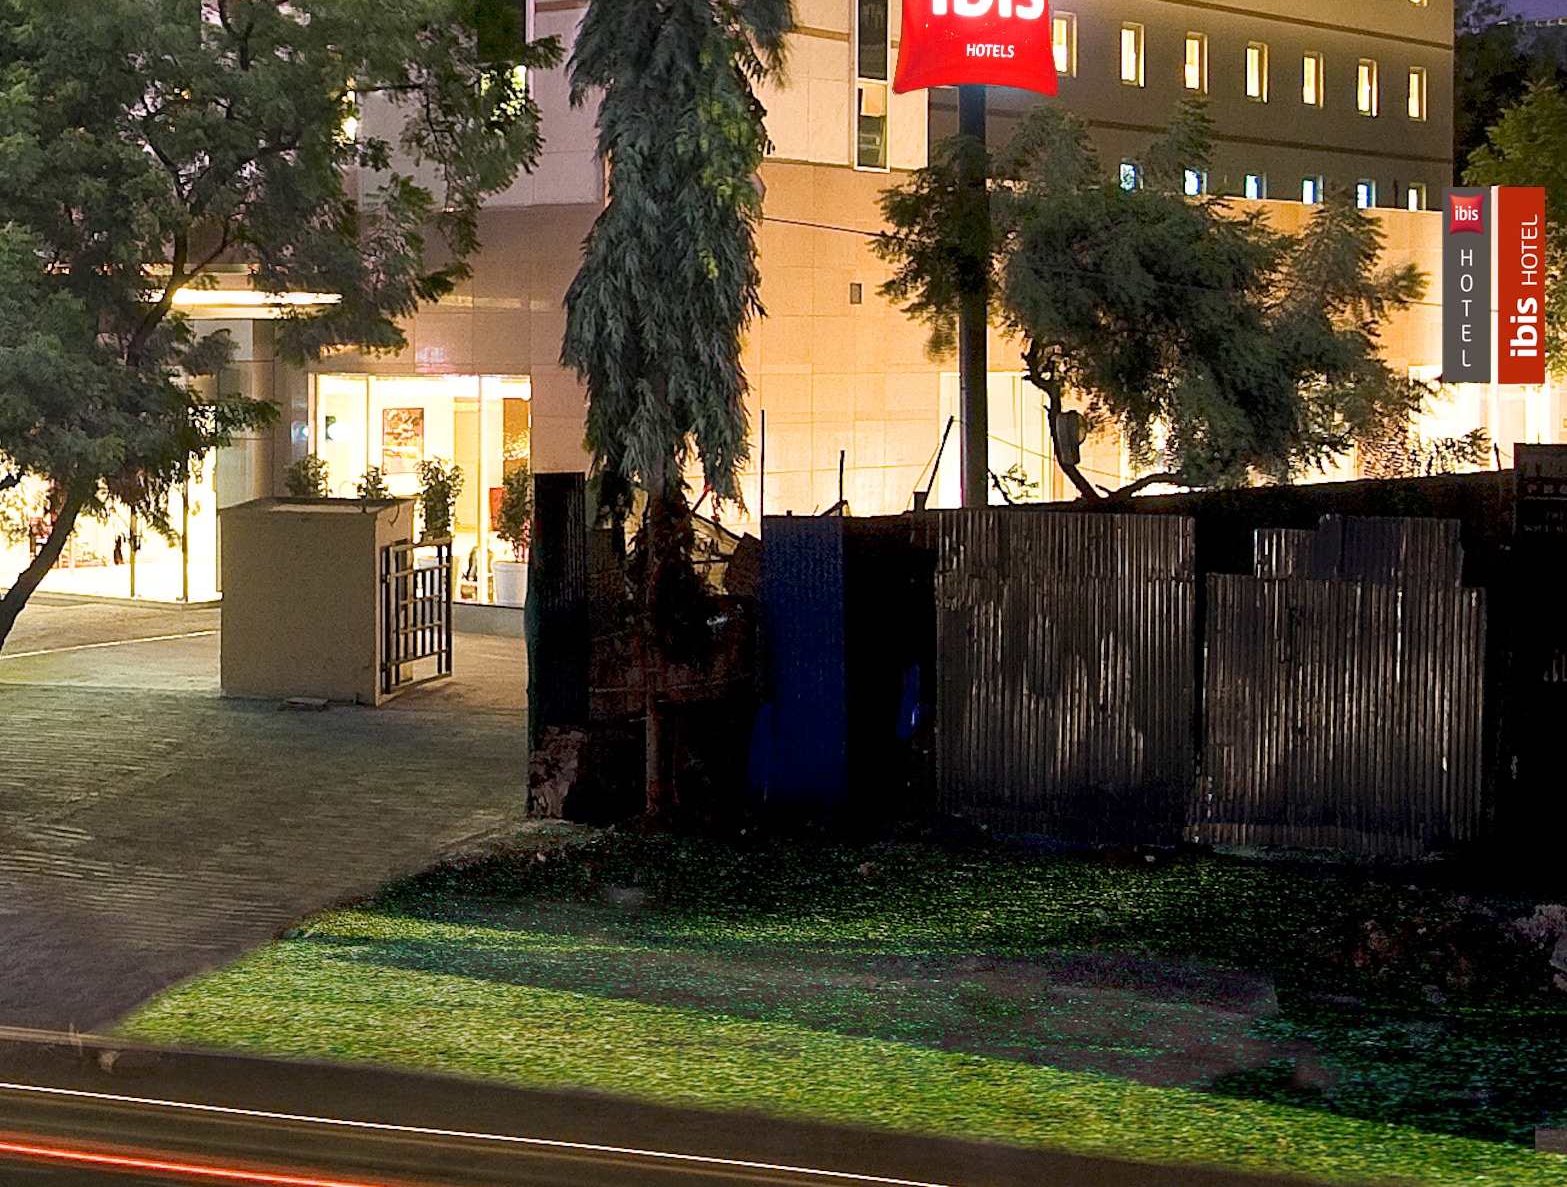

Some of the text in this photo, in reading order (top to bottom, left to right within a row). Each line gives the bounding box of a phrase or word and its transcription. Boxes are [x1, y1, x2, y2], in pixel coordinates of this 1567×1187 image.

[966, 43, 1015, 58] HOTELS
[1454, 205, 1479, 221] ibis
[1460, 249, 1474, 367] HOTEL
[1510, 214, 1538, 357] ibis HOTEL
